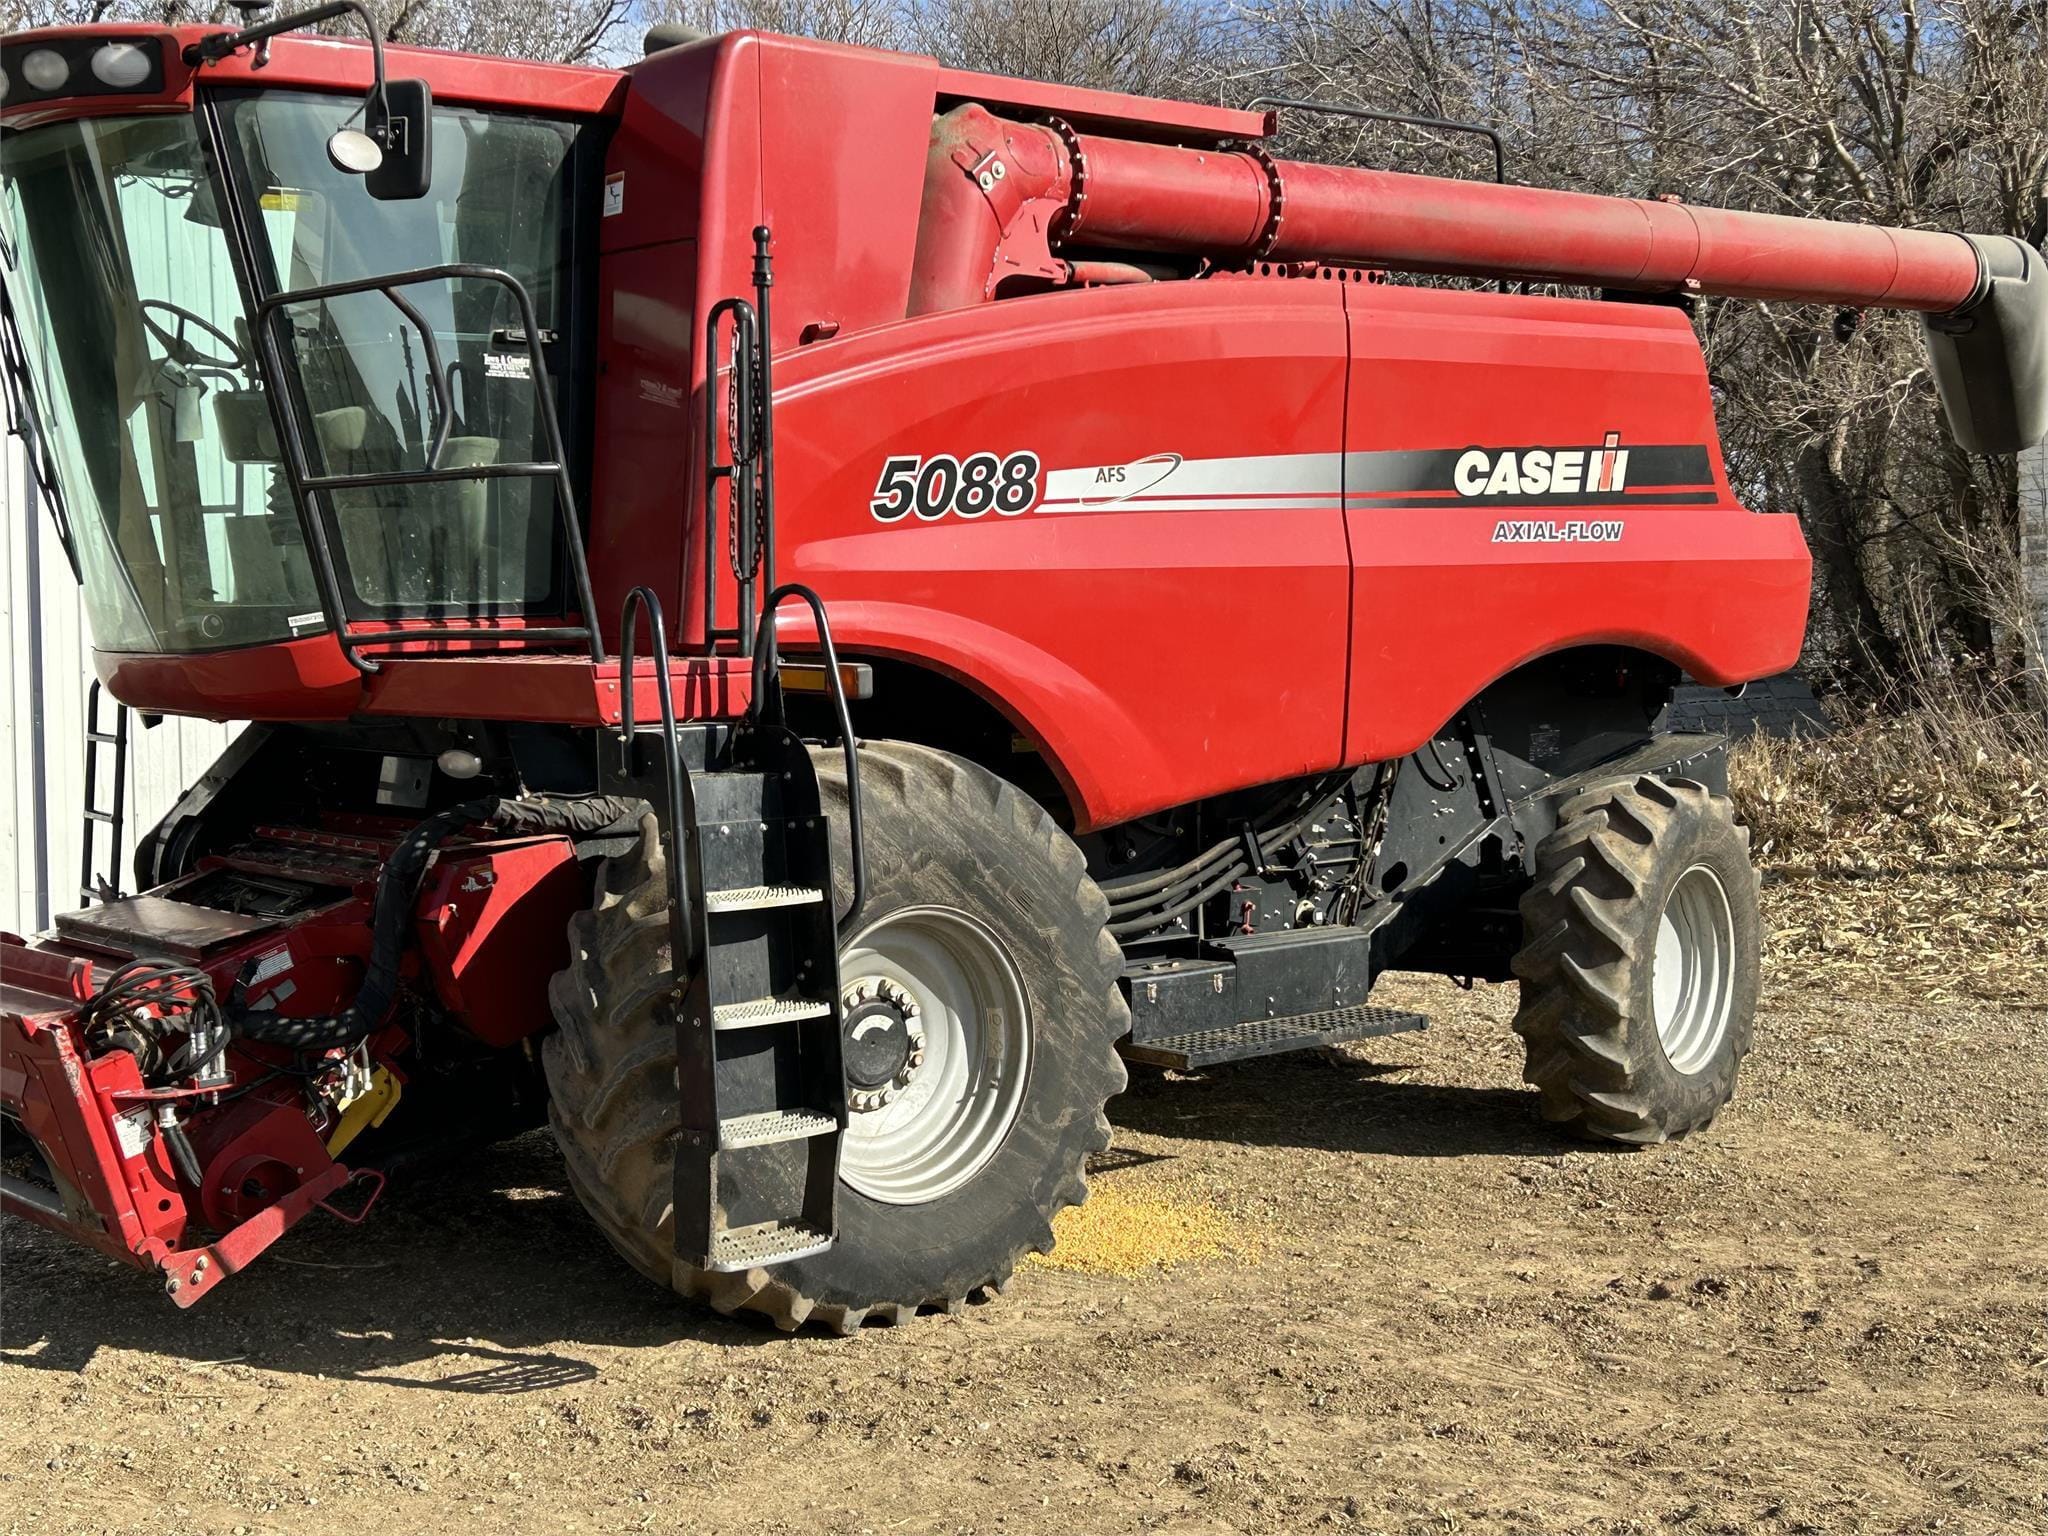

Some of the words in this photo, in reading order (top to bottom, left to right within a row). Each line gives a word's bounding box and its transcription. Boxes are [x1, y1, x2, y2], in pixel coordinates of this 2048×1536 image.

[871, 452, 1039, 522] 5088
[1094, 466, 1126, 484] AFS
[1454, 450, 1585, 497] CASE
[1492, 521, 1623, 542] AXIAL-FLOW
